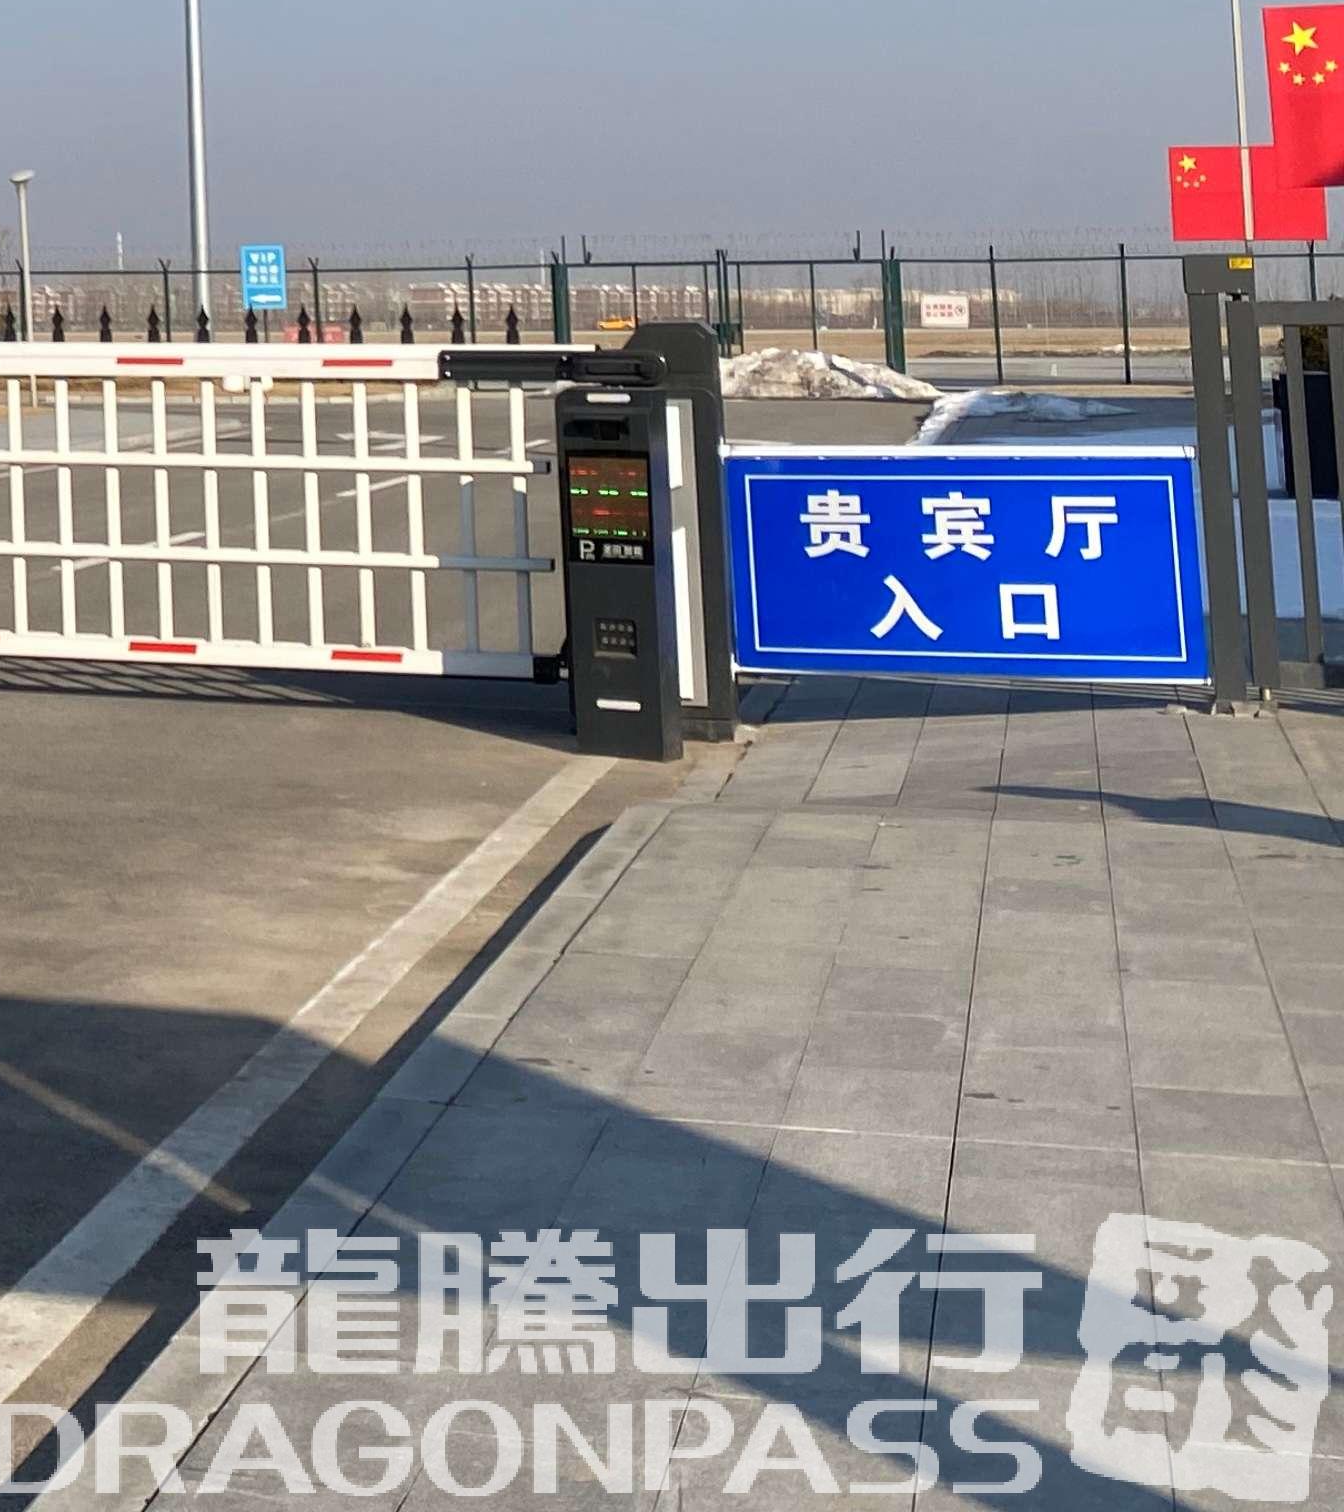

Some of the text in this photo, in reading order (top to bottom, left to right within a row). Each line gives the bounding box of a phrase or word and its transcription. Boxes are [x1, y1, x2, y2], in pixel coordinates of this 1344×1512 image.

[249, 252, 277, 264] VIP
[799, 489, 1119, 561] 贵宾厅
[870, 574, 1061, 641] 入口
